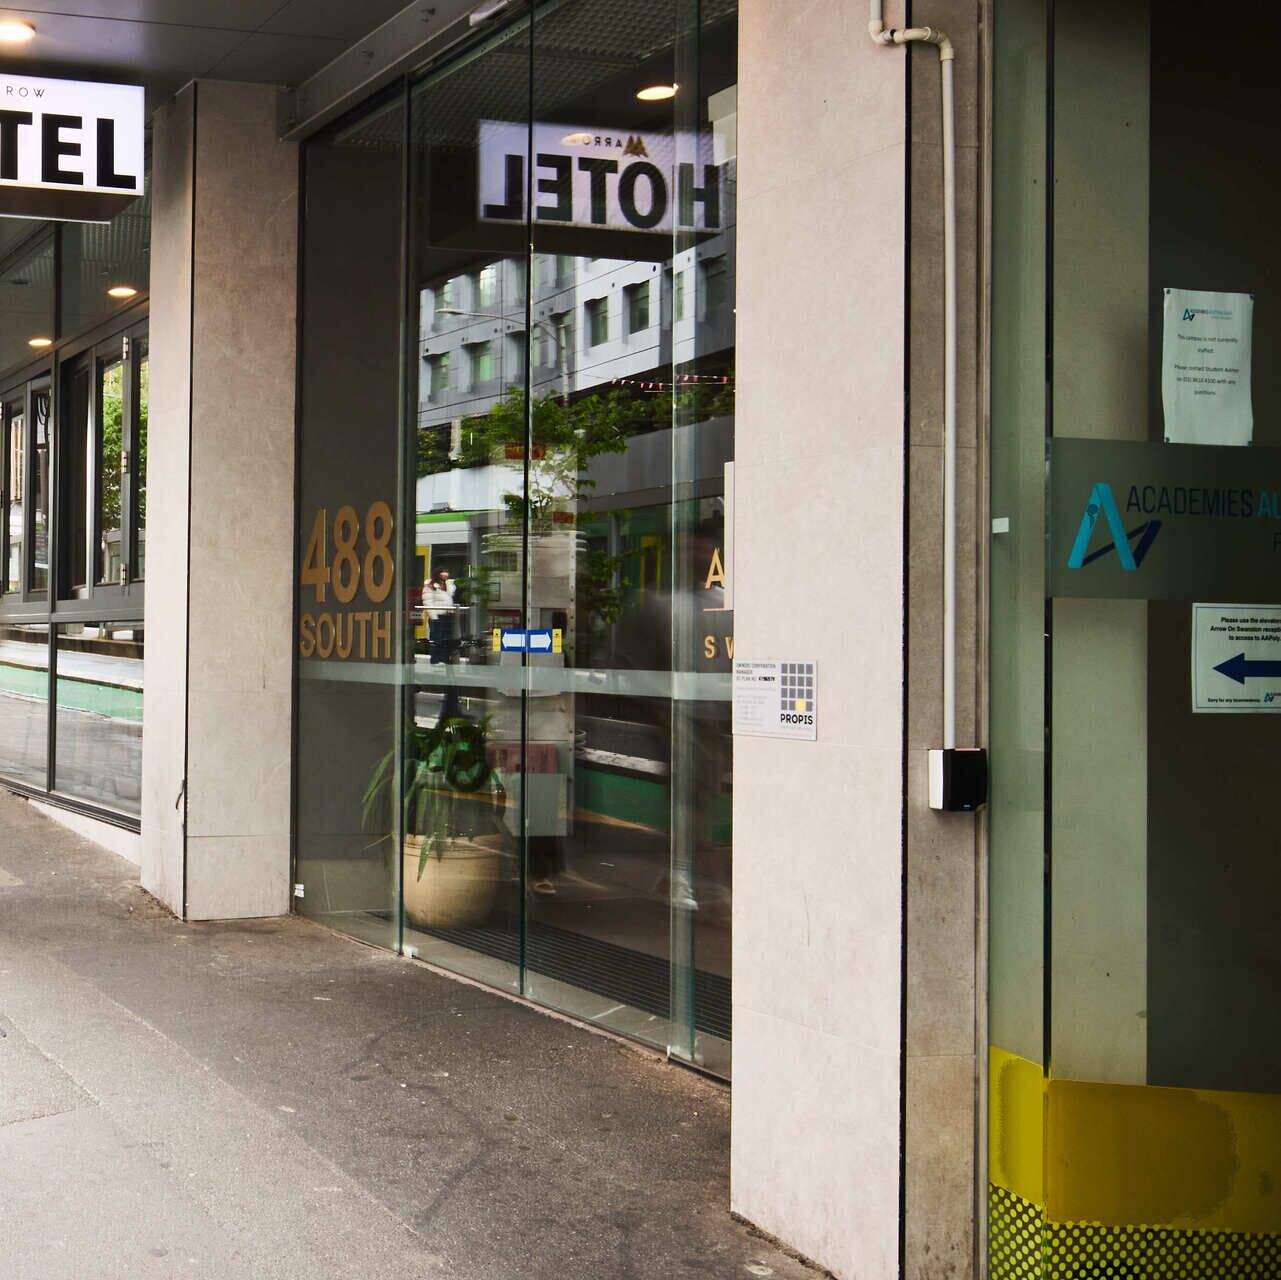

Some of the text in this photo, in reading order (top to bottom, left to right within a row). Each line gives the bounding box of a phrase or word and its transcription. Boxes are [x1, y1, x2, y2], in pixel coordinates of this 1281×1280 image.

[1126, 485, 1253, 518] ACADEMIES
[301, 500, 395, 604] 488
[299, 610, 392, 660] SOUTH
[780, 713, 814, 726] PROPIS
